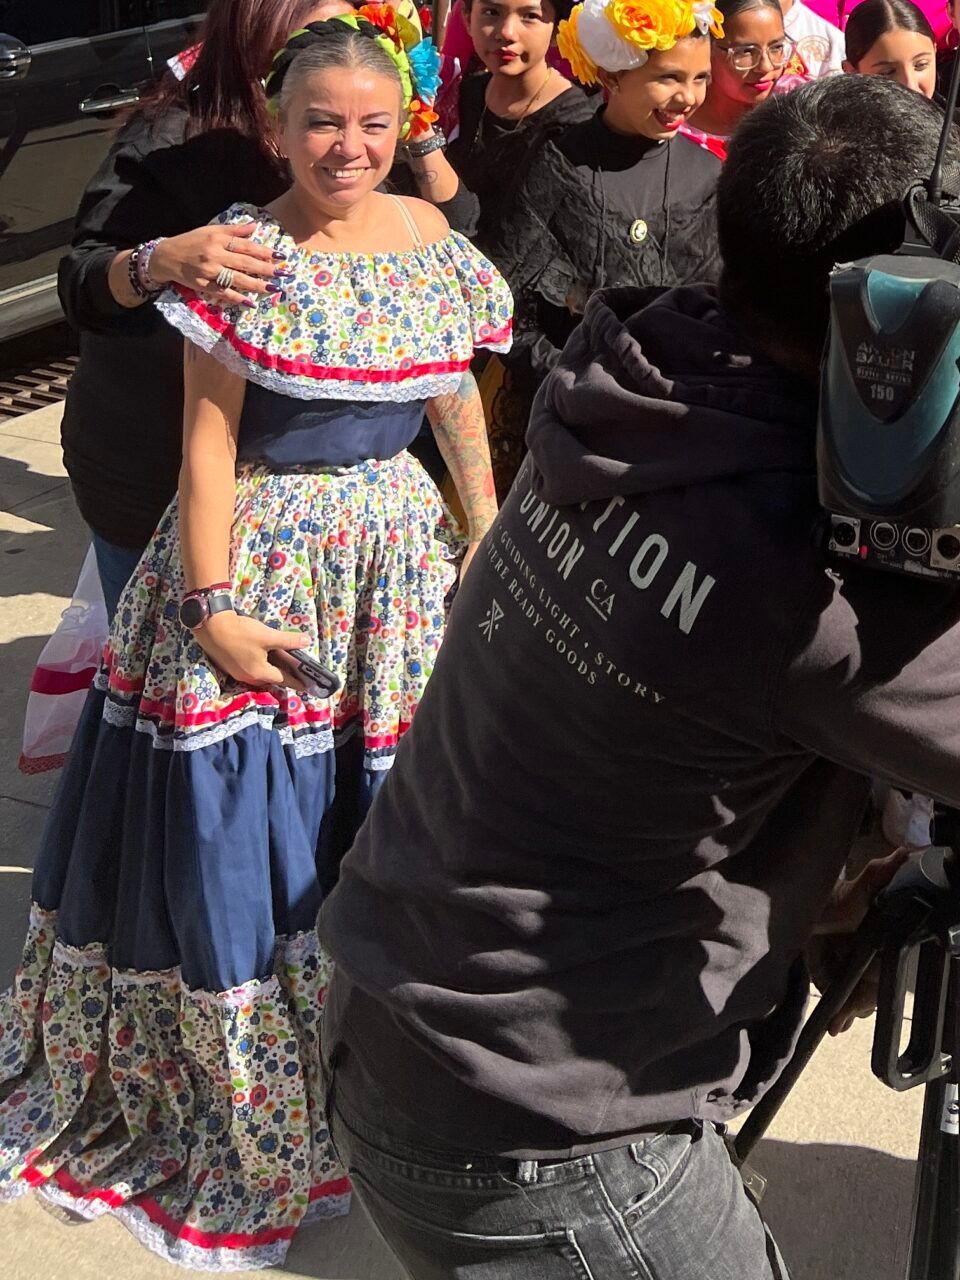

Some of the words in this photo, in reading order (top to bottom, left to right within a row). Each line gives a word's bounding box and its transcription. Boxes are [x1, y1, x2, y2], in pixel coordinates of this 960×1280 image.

[870, 384, 895, 401] 150
[520, 489, 585, 581] UNION
[580, 495, 716, 635] TION
[501, 533, 537, 591] GUIDING
[539, 588, 581, 638] LIGHT
[594, 651, 666, 704] STORY
[508, 579, 543, 629] READY
[546, 628, 597, 685] GOODS
